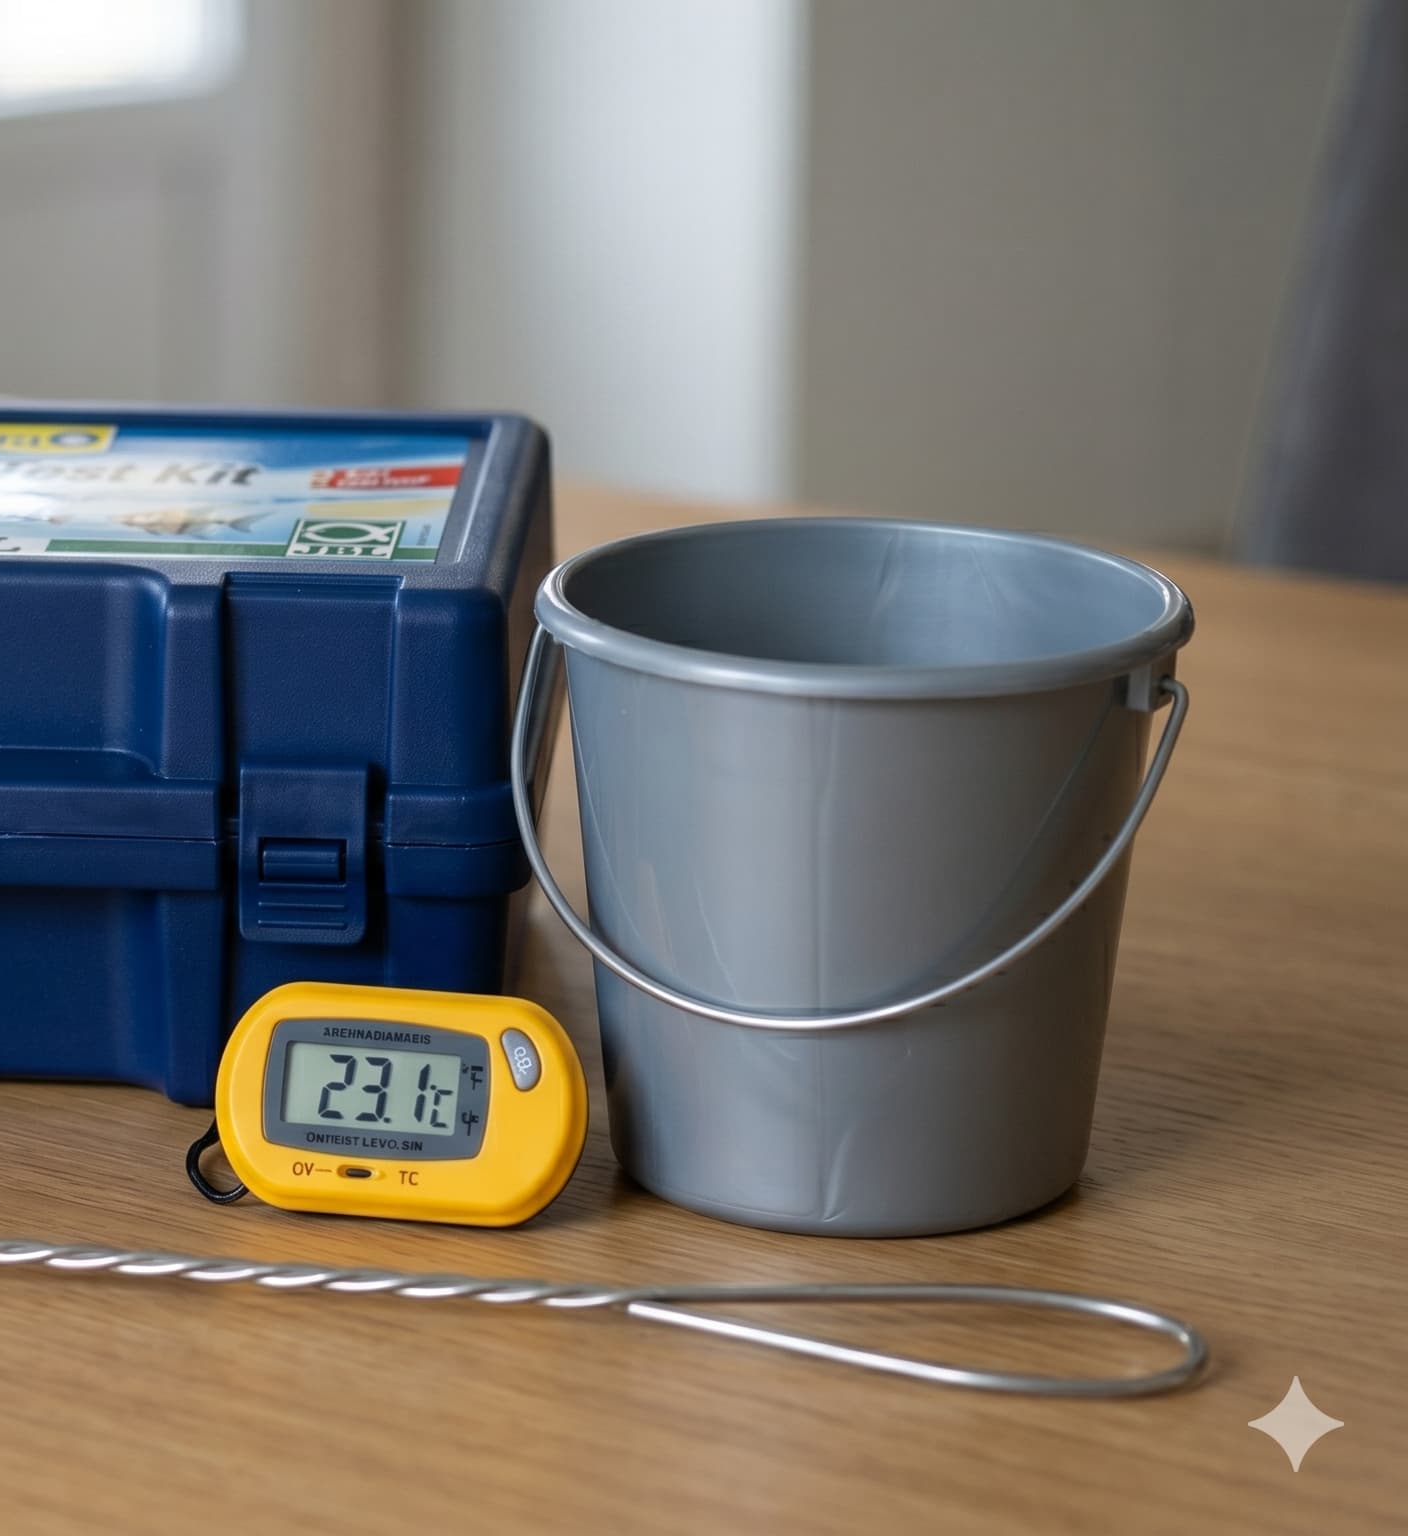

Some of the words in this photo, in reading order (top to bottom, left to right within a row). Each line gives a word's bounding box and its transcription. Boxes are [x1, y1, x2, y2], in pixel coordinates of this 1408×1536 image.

[153, 462, 262, 486] Kit
[292, 545, 387, 557] JBL
[401, 1140, 424, 1152] SIN
[399, 1170, 419, 1186] TC
